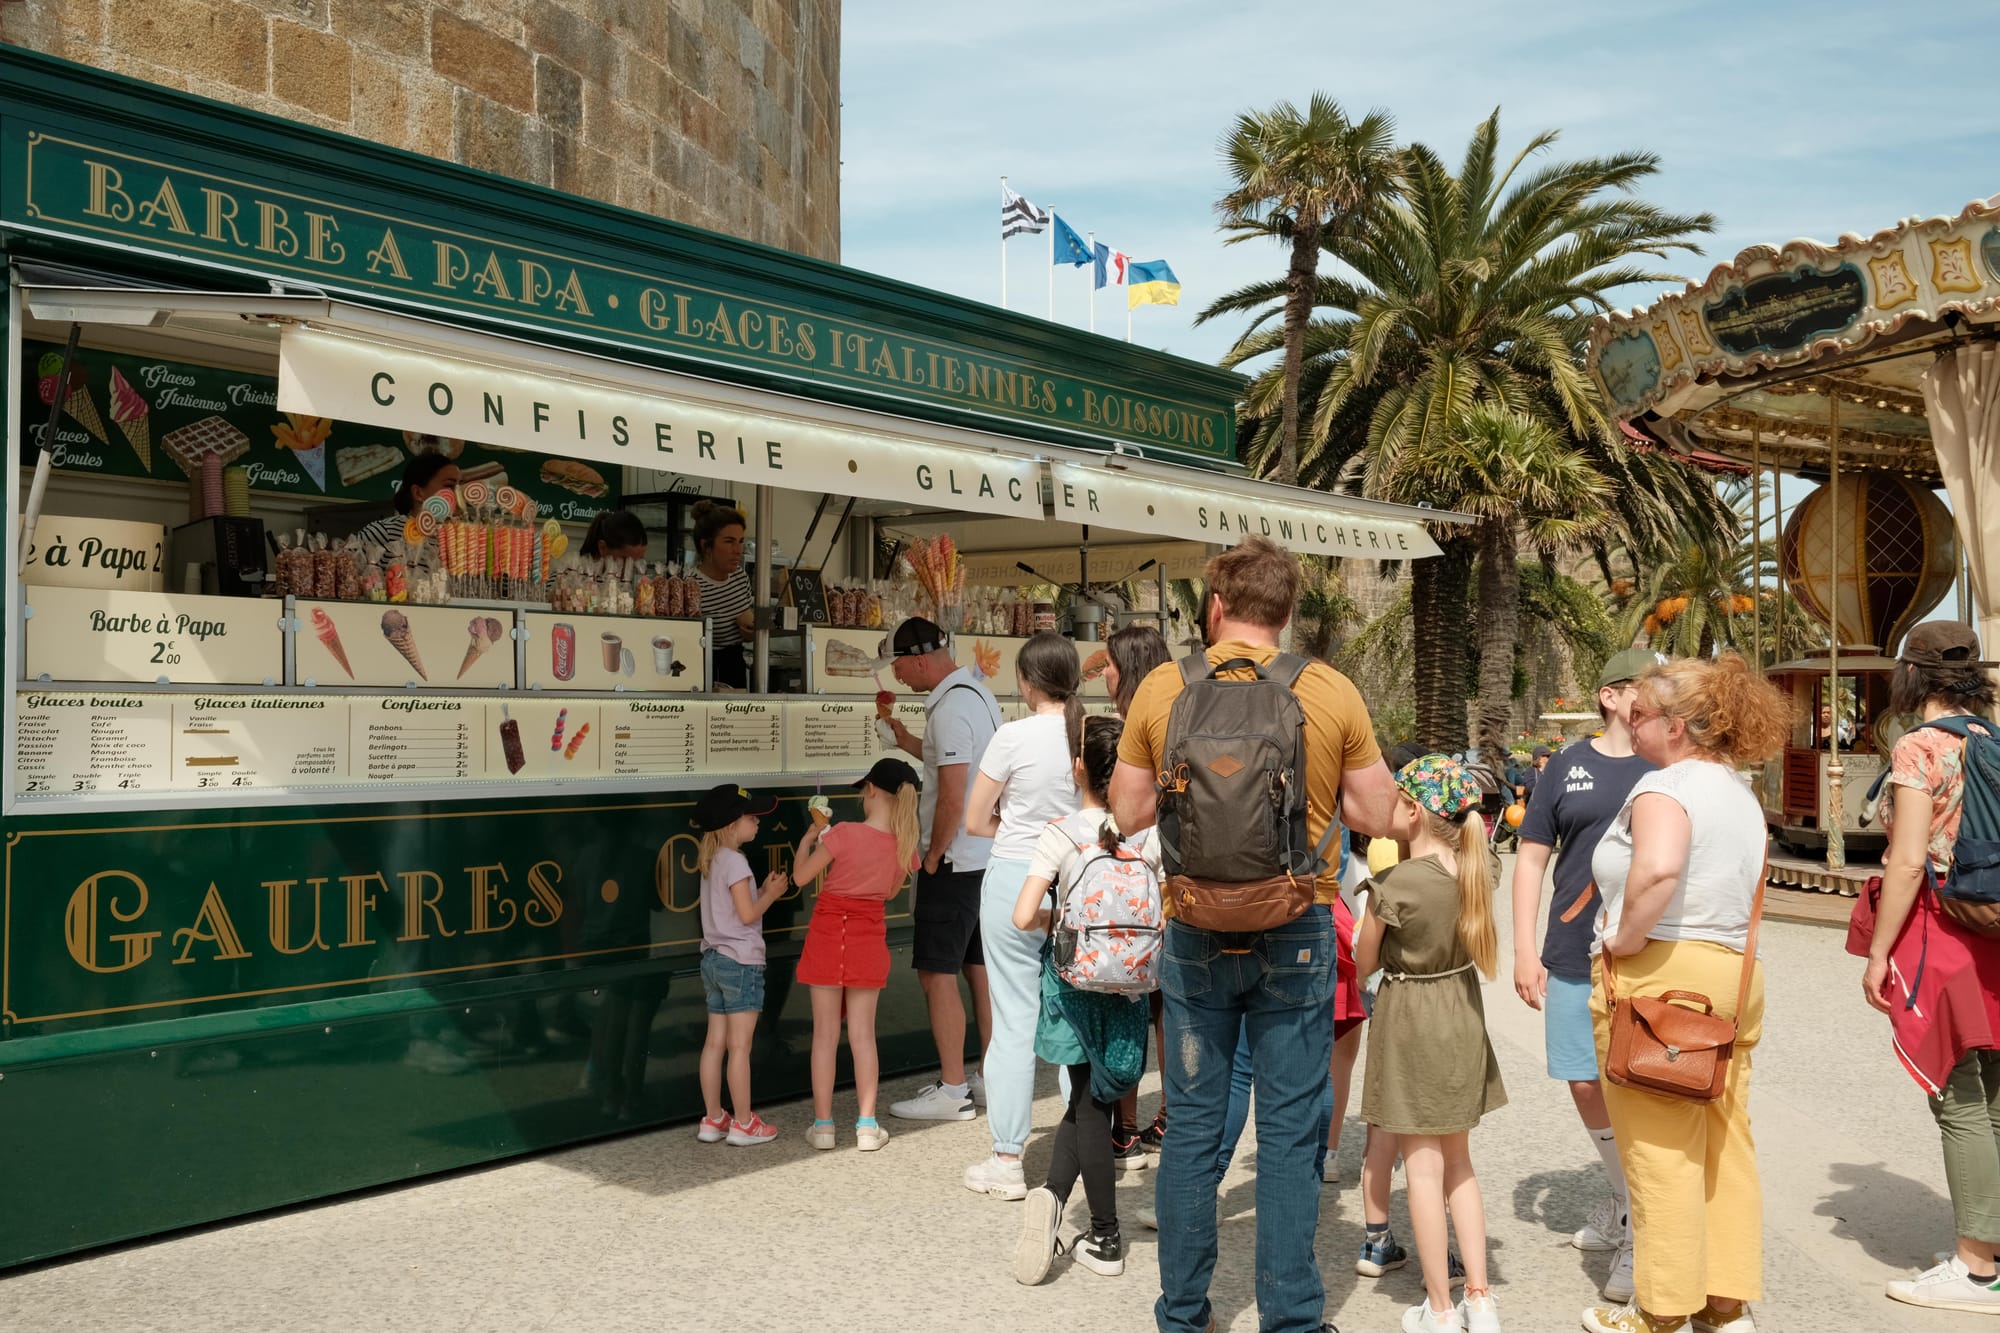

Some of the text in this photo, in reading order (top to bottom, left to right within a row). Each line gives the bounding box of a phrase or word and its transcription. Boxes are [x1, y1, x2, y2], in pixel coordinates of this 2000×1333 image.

[83, 160, 1215, 448] BARBE A PAPA GLACES ITALIENNES BOISSONS
[140, 365, 196, 388] Glaces
[155, 388, 228, 412] Italiennes
[51, 444, 103, 467] Boules
[370, 371, 1409, 550] CONFISERIE GLACIER SANDWICHERIE
[240, 463, 300, 486] Gaufres
[45, 535, 71, 566] à
[79, 537, 147, 579] Papa
[90, 609, 227, 641] Barbe à Papa
[27, 695, 143, 708] Glaces boules
[194, 698, 325, 710] Glaces italiennes
[382, 699, 461, 712] Confiseries
[630, 702, 685, 712] Boissons
[725, 703, 765, 714] Gaufres
[822, 703, 853, 714] Crêpes
[1566, 782, 1594, 793] MLM
[64, 860, 564, 976] GAUFRES
